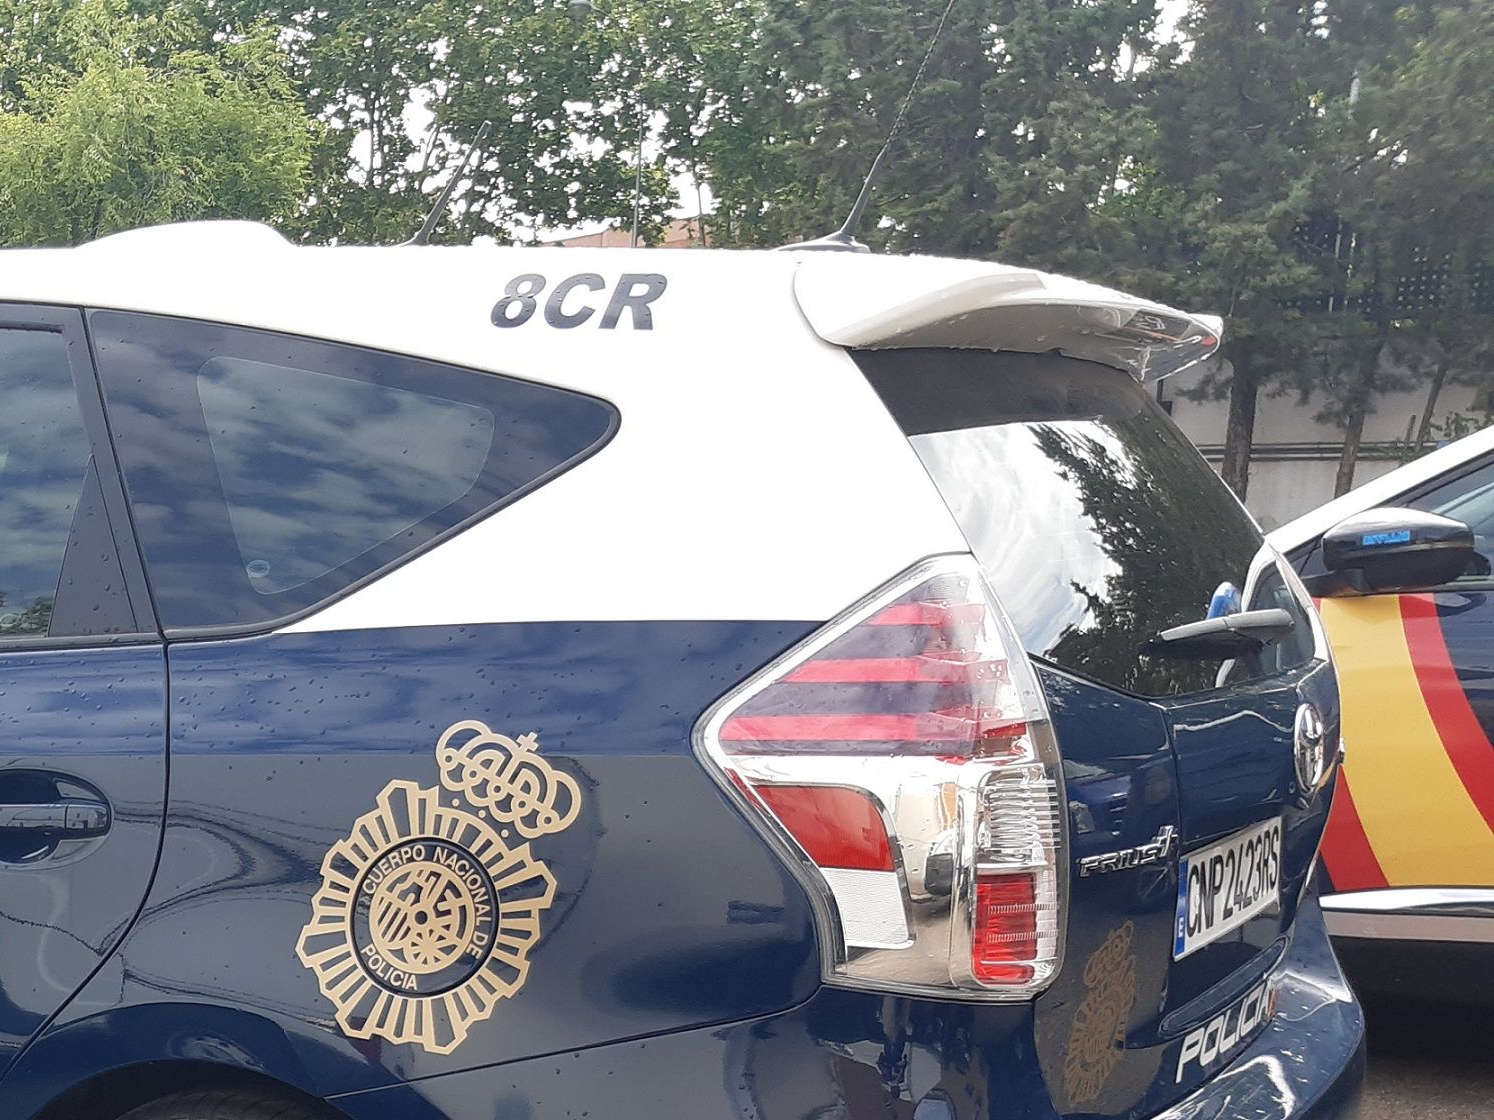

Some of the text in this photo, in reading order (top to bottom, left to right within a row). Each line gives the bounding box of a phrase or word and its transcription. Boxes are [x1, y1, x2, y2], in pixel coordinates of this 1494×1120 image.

[490, 272, 668, 330] 8CR
[362, 844, 492, 960] CUERPO NACIONAL DE
[360, 943, 418, 991] POLICIA
